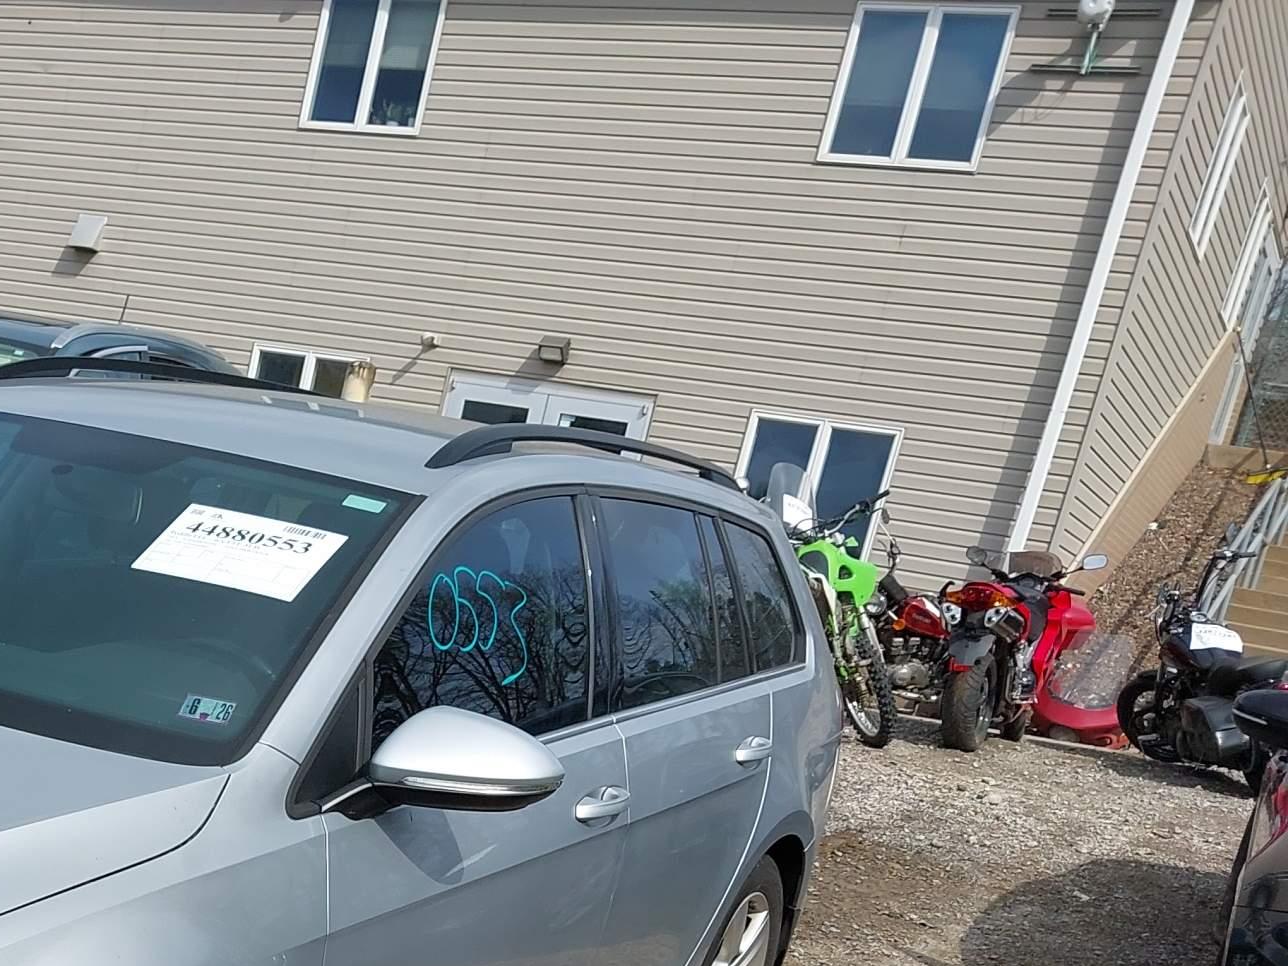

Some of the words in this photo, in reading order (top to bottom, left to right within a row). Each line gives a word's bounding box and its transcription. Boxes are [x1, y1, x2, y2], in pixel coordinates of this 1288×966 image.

[186, 521, 313, 554] 44880553
[429, 566, 527, 685] 0553
[188, 698, 201, 715] 6
[215, 703, 234, 721] 26
